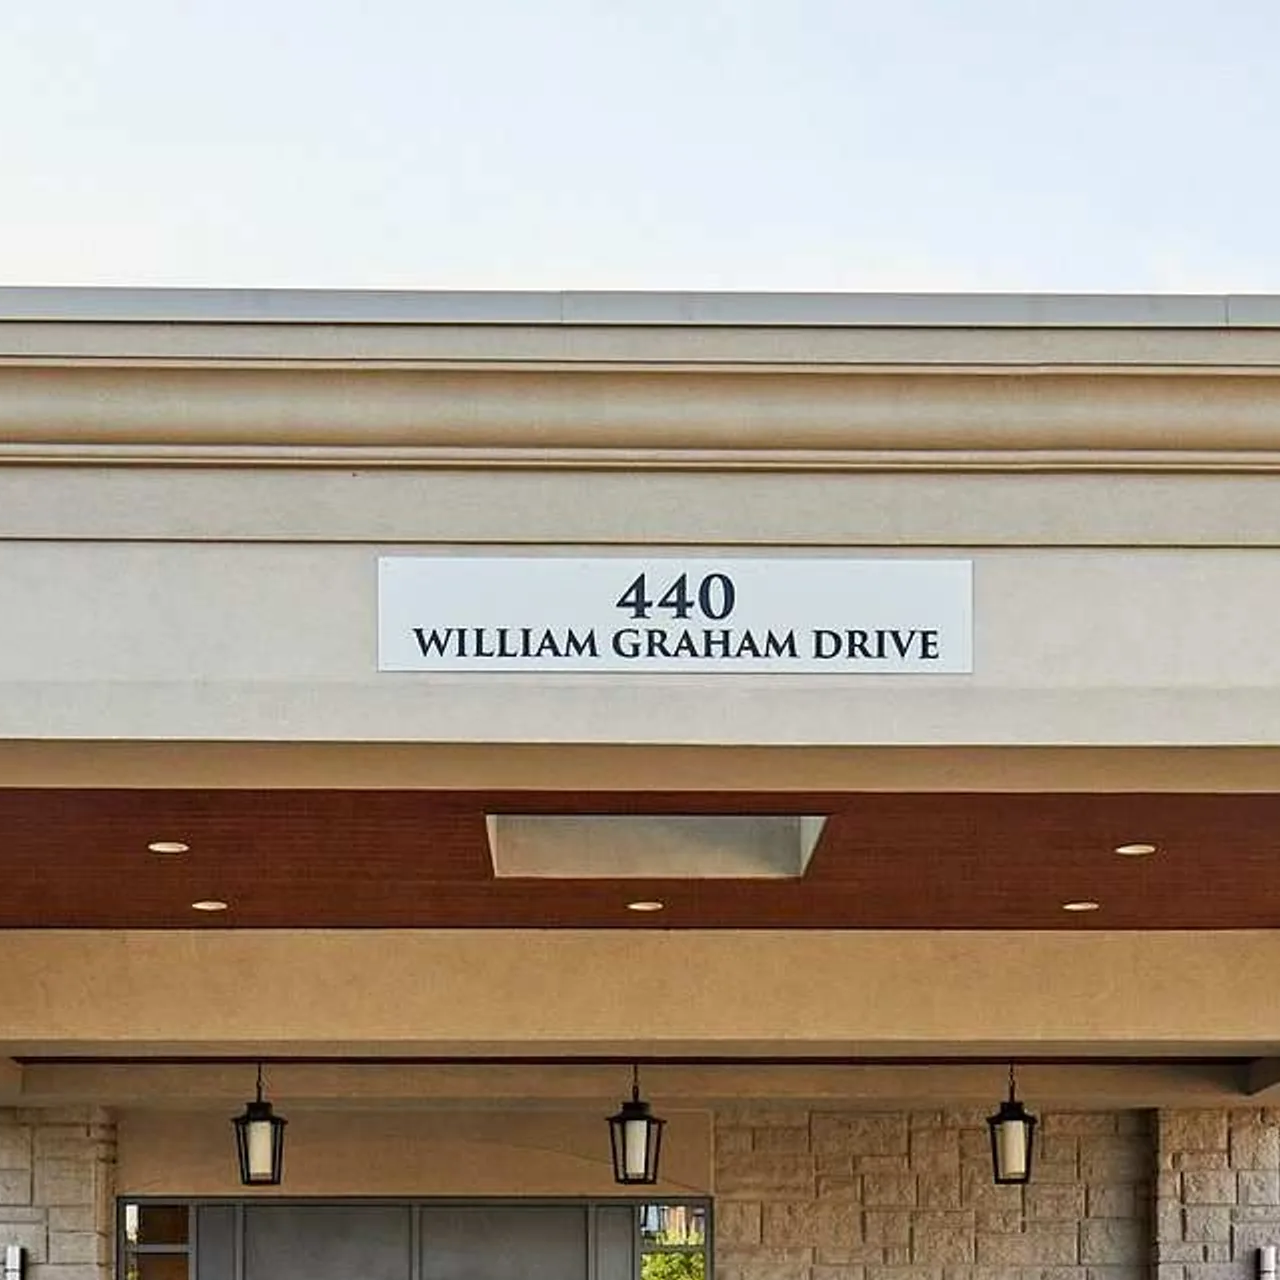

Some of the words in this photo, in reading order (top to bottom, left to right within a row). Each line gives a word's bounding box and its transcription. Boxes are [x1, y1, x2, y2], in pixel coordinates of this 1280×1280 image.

[615, 572, 736, 620] 440
[412, 628, 600, 658] WILLIAM
[611, 628, 800, 659] GRAHAM
[812, 629, 940, 660] DRIVE
